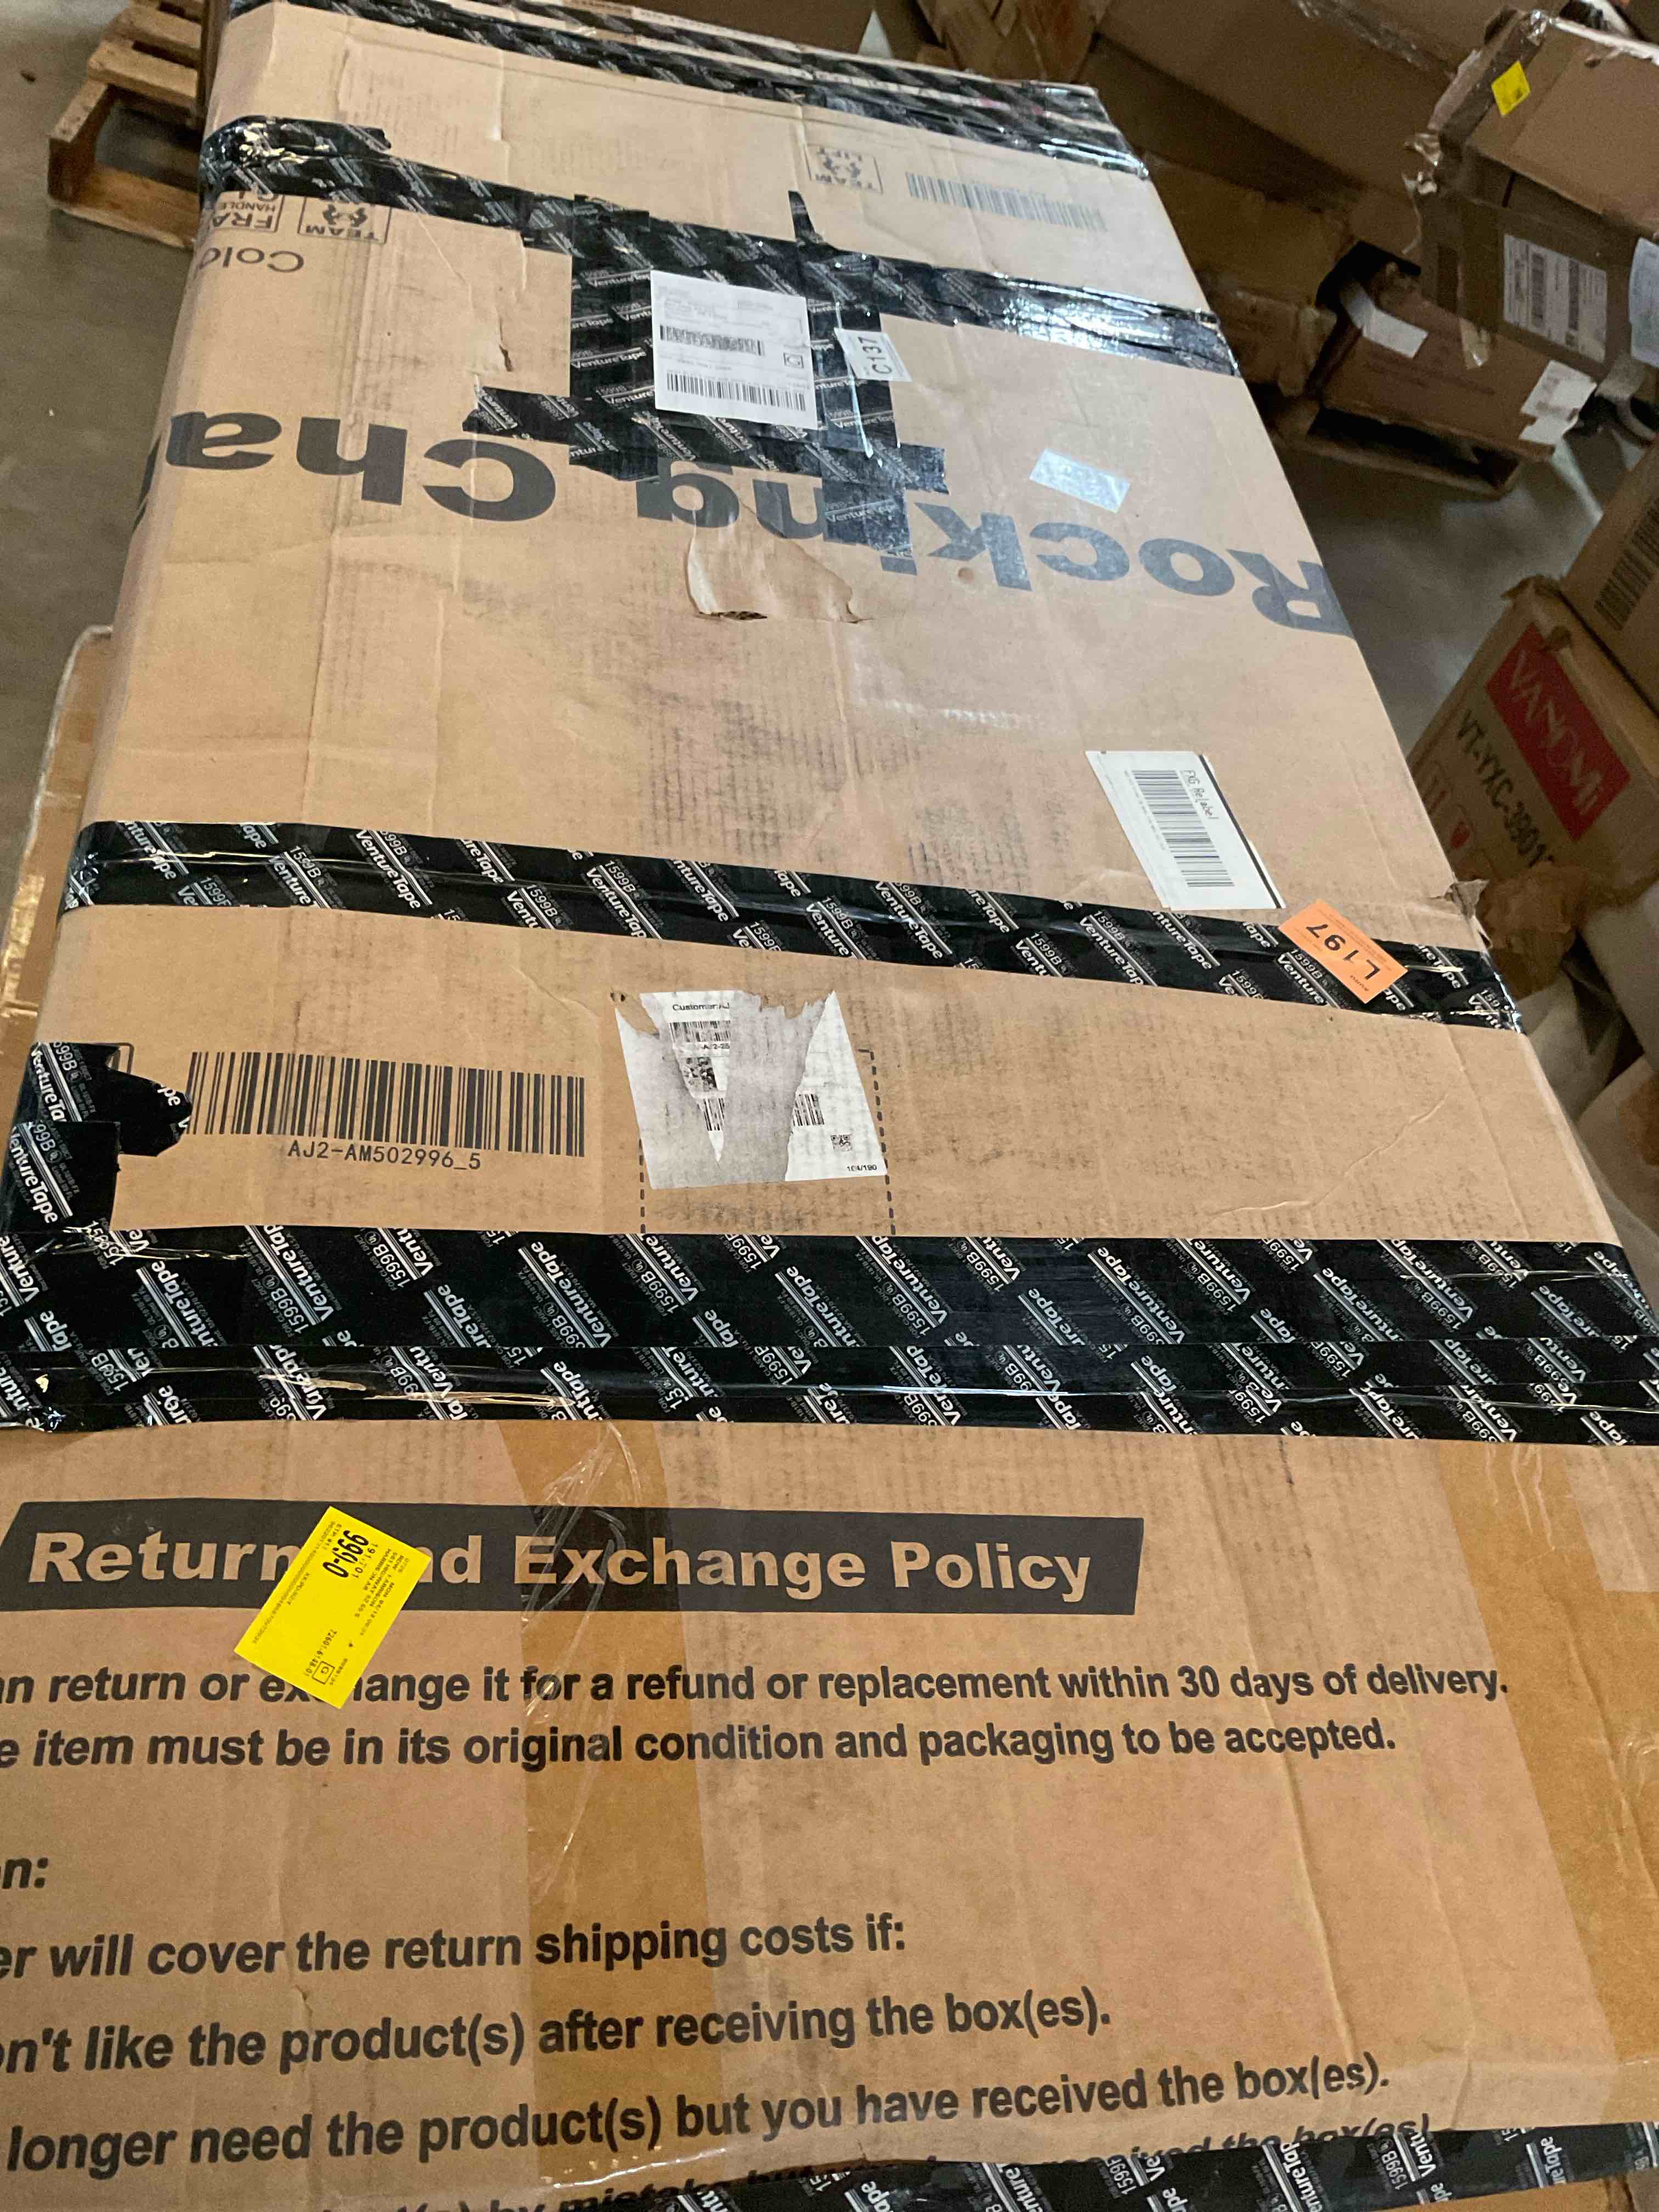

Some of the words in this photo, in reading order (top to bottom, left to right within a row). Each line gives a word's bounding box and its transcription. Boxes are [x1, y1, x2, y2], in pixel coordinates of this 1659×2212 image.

[306, 225, 376, 240] TEAM
[861, 335, 893, 376] C137
[636, 460, 1354, 637] Rockng
[355, 830, 421, 909] VentureTape
[604, 860, 637, 893] 1599B
[526, 883, 558, 917] 1599B
[822, 895, 854, 930] 1599B
[876, 881, 944, 960] VentureTape
[1093, 909, 1125, 942] 1599B
[1030, 932, 1062, 966] 1599B
[1290, 949, 1323, 979] 1599B
[287, 1139, 481, 1170] AJ2-AM502996_5
[373, 1244, 410, 1288] 1599B
[966, 1251, 1005, 1293] 1599B
[270, 1288, 309, 1334] 1599B
[530, 1240, 613, 1348] VentureTape
[641, 1270, 680, 1314] 1599B
[1097, 1246, 1186, 1344] VentureTape
[1197, 1272, 1237, 1312] 1599B
[1421, 1291, 1463, 1331] 1599B
[891, 1293, 931, 1336] 1599B
[322, 1530, 370, 1578] 999-0
[514, 1534, 866, 1600] Exchange
[890, 1541, 1091, 1603] Policy
[48, 1667, 185, 1703] return
[200, 1673, 250, 1703] or
[259, 1672, 470, 1711] exange
[484, 1666, 510, 1702] it
[521, 1664, 579, 1701] for
[590, 1671, 614, 1701] a
[628, 1665, 755, 1701] refund
[767, 1671, 809, 1700] or
[818, 1666, 1052, 1707] replacement
[1058, 1665, 1170, 1699] within
[1180, 1664, 1221, 1697] 30
[1230, 1665, 1314, 1705] days
[1322, 1663, 1358, 1695] of
[1367, 1662, 1508, 1702] delivery.
[33, 1729, 135, 1766] item
[149, 1730, 264, 1766] must
[274, 1729, 331, 1766] be
[343, 1729, 383, 1766] in
[397, 1729, 451, 1765] its
[464, 1725, 622, 1772] original
[635, 1723, 825, 1762] condition
[835, 1722, 907, 1759] and
[919, 1722, 1115, 1765] packaging
[1122, 1724, 1160, 1755] to
[1168, 1720, 1215, 1754] be
[1223, 1717, 1395, 1759] accepted.
[49, 1933, 134, 1978] will
[148, 1940, 286, 1976] cover
[296, 1930, 369, 1972] the
[385, 1928, 522, 1970] return
[535, 1920, 727, 1971] shipping
[740, 1916, 854, 1956] costs
[865, 1912, 906, 1951] if:
[84, 2024, 174, 2071] like
[188, 2022, 265, 2066] the
[279, 2012, 524, 2074] product(s)
[539, 2008, 645, 2054] after
[656, 2000, 855, 2048] receiving
[865, 1995, 934, 2036] the
[945, 1986, 1111, 2039] box(es).
[6, 2125, 177, 2180] longer
[189, 2113, 312, 2163] need
[327, 2110, 404, 2158] the
[418, 2096, 661, 2163] product(s)
[676, 2094, 752, 2138] but
[761, 2093, 843, 2142] you
[856, 2085, 960, 2125] have
[972, 2068, 1148, 2119] received
[1158, 2064, 1225, 2107] the
[1233, 2051, 1390, 2100] box(es).
